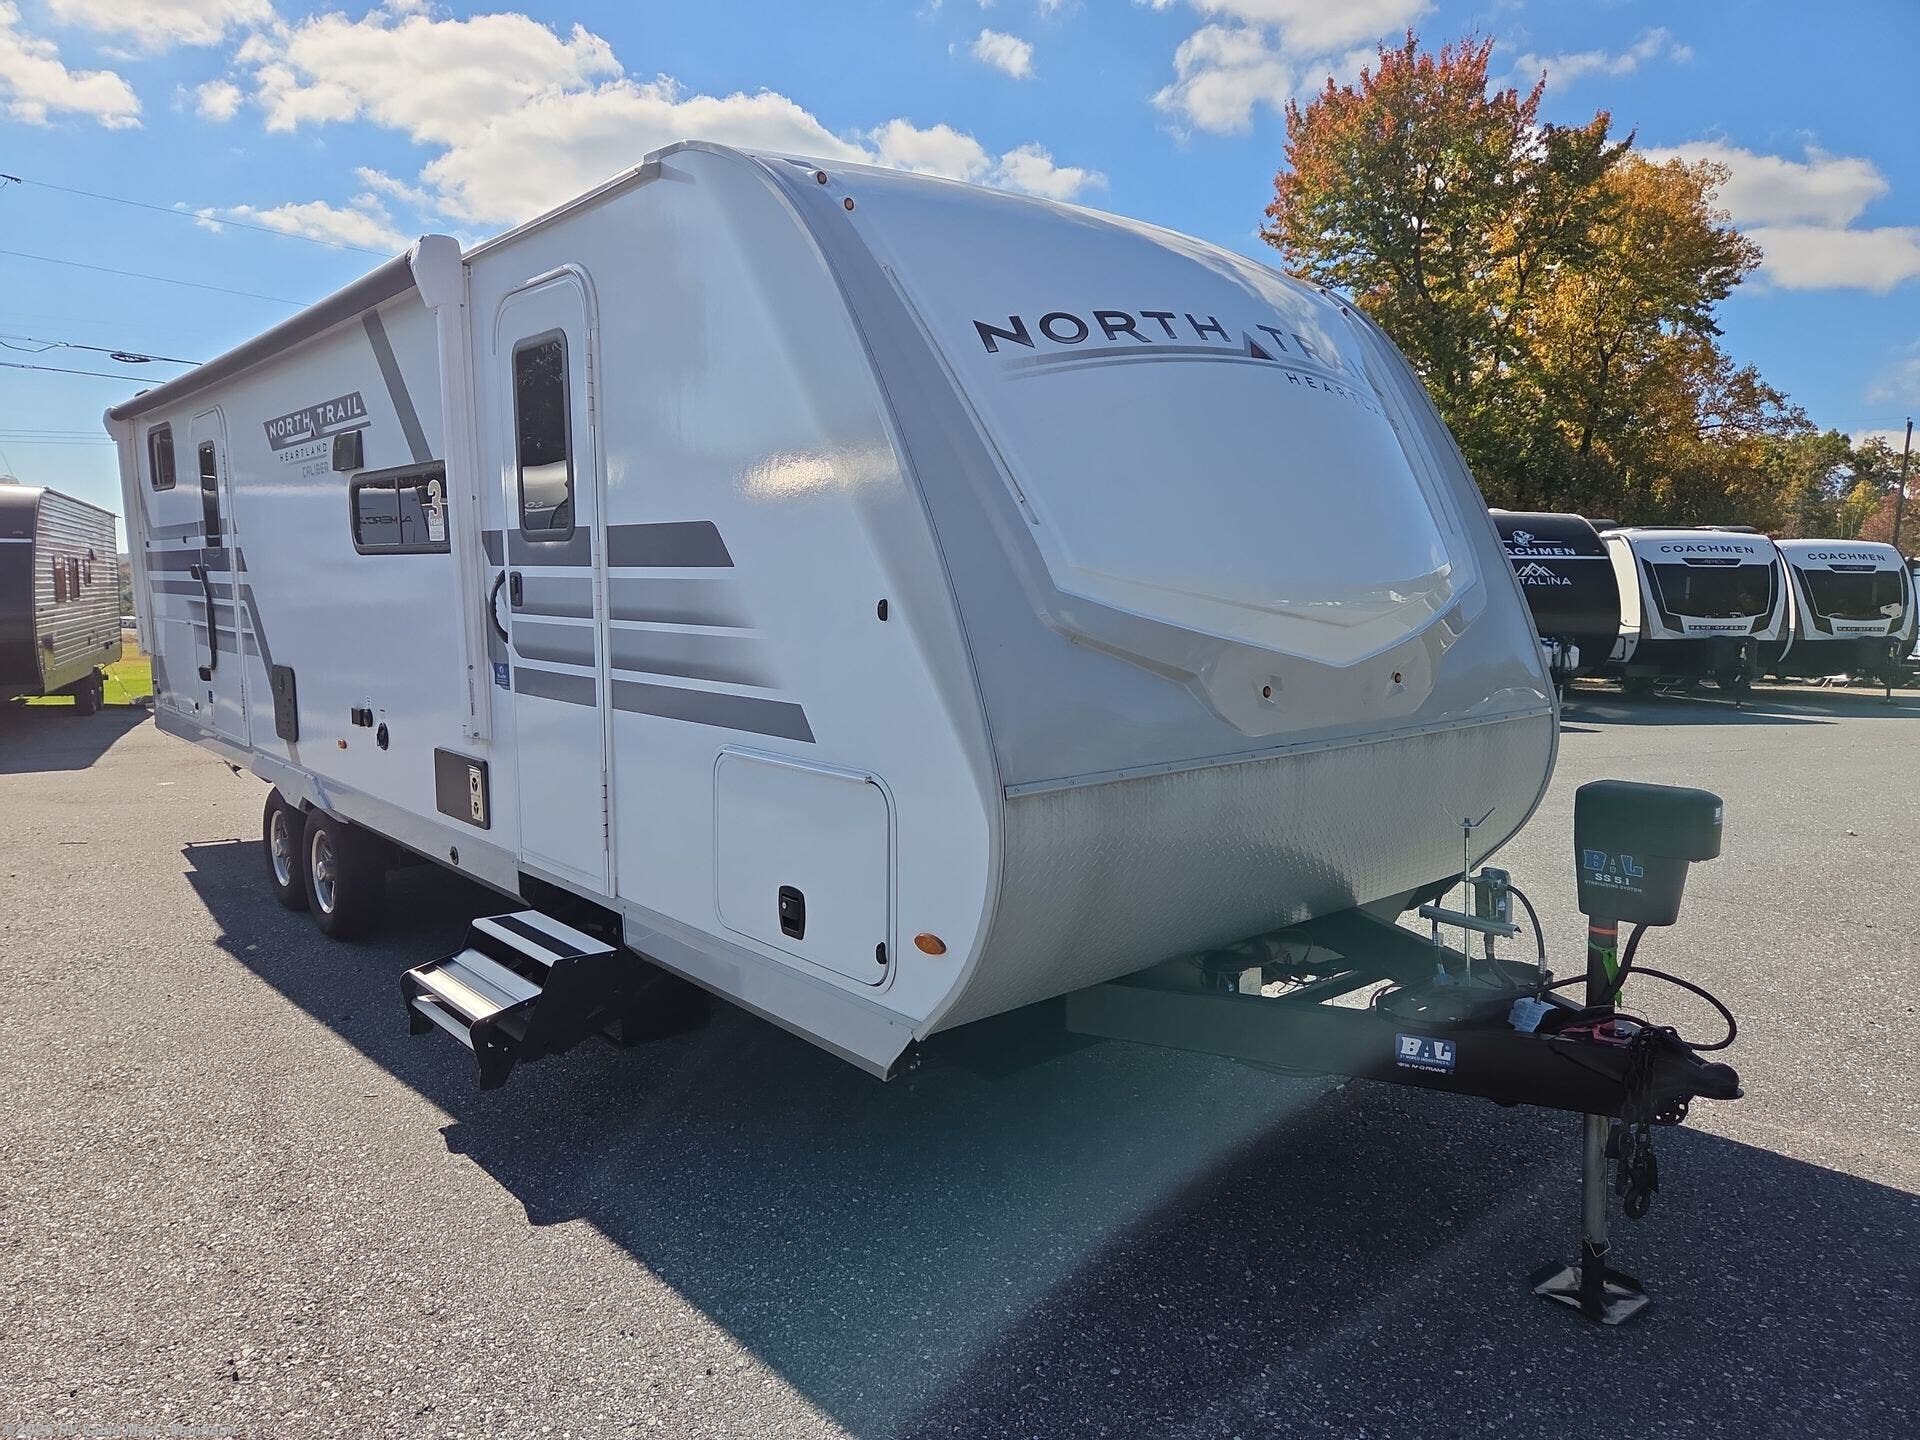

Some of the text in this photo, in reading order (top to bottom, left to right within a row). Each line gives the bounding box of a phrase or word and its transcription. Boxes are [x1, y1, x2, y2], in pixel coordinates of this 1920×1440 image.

[972, 310, 1232, 353] NORTH
[269, 397, 361, 438] NORTH TRAIL
[280, 443, 328, 462] HEARTLAND
[1505, 547, 1576, 555] ACHMEN
[1660, 545, 1755, 554] COACHMEN
[1807, 552, 1886, 561] COACHMEN
[1519, 576, 1572, 585] TALINA
[1583, 849, 1644, 878] BAL
[1595, 872, 1611, 882] SS
[1400, 1036, 1452, 1061] BAL
